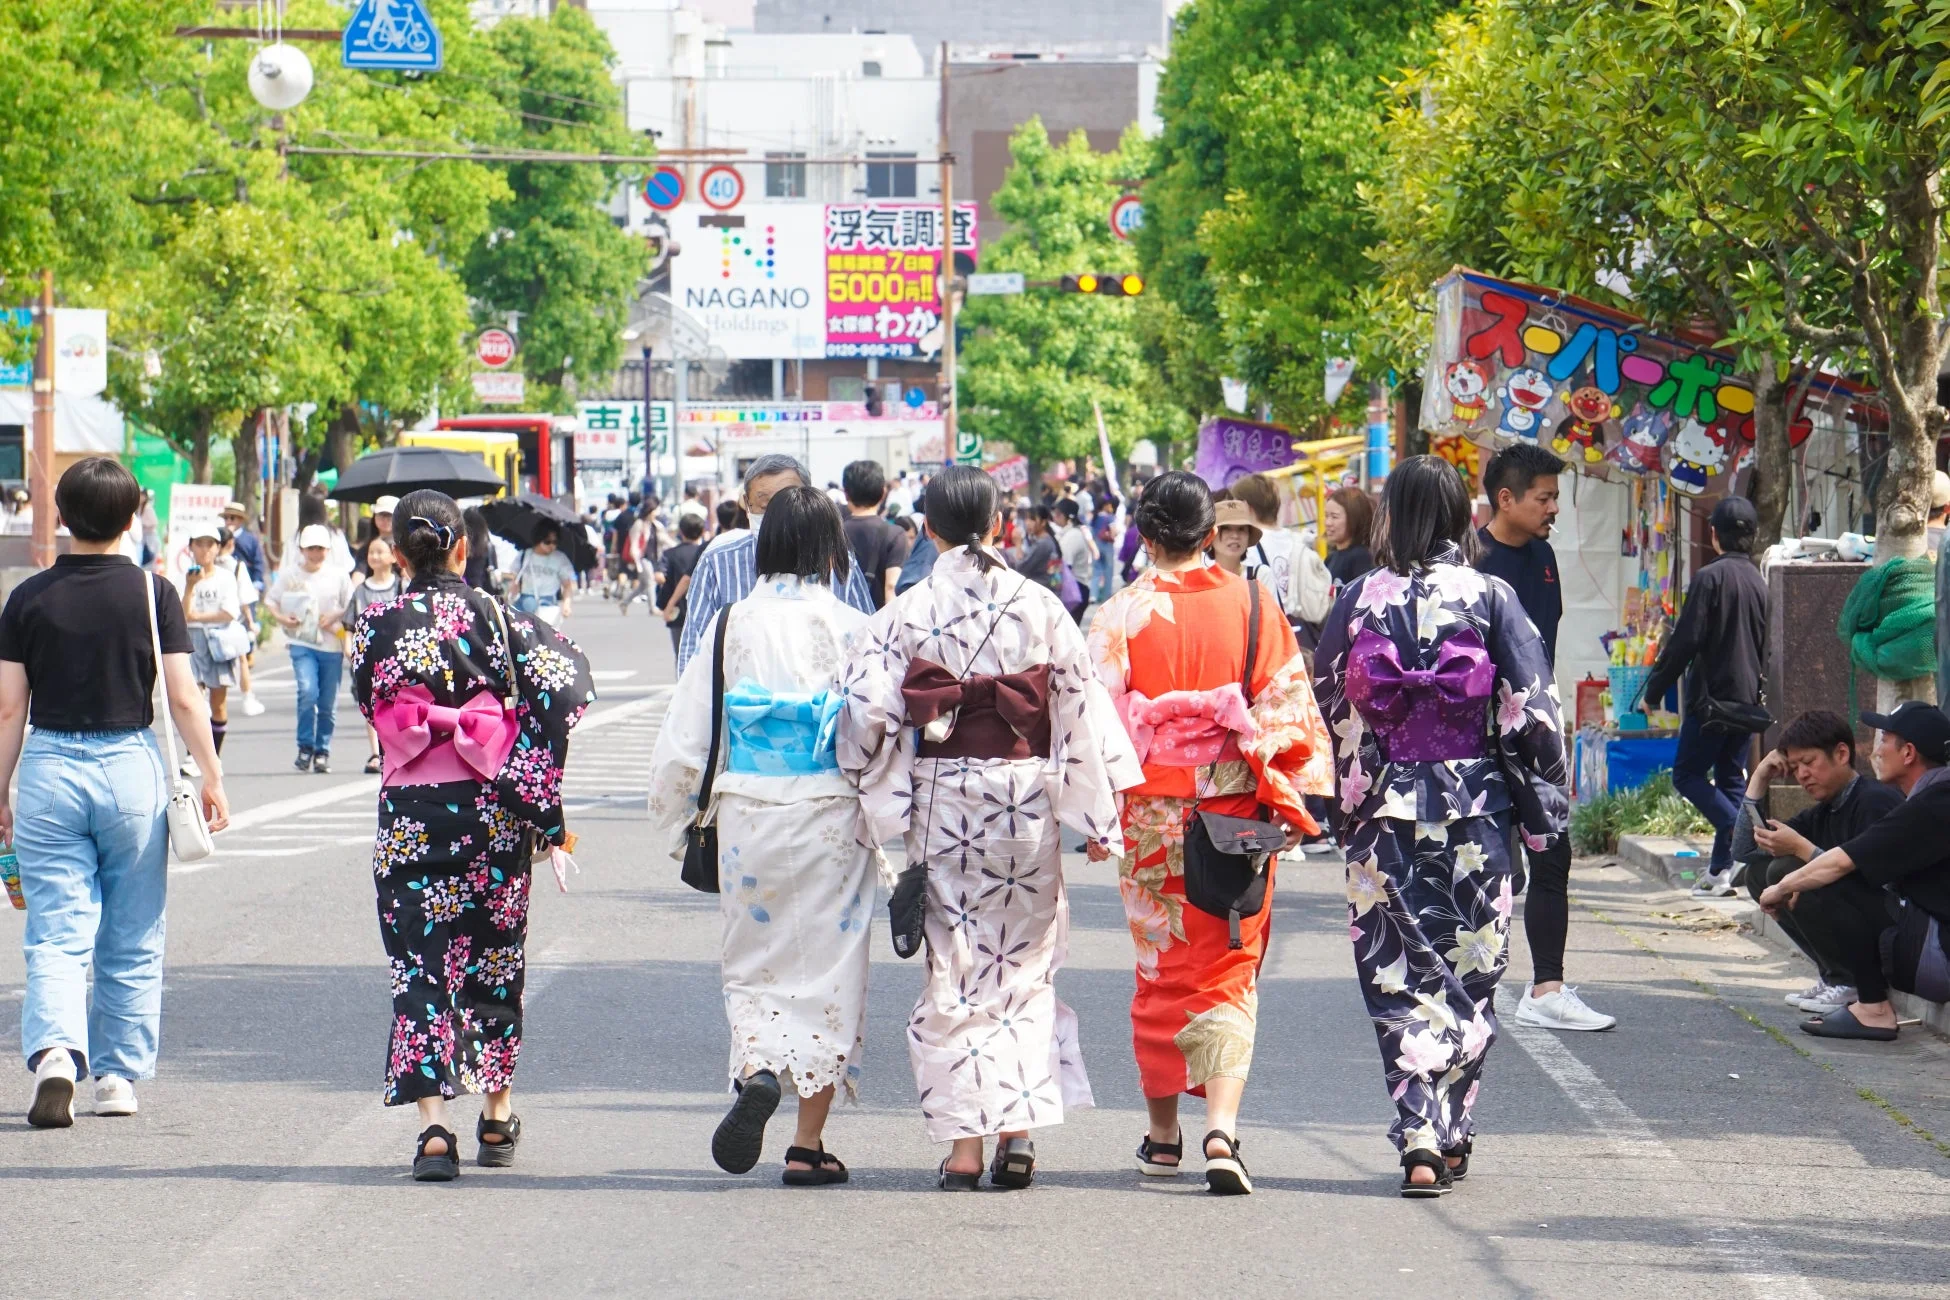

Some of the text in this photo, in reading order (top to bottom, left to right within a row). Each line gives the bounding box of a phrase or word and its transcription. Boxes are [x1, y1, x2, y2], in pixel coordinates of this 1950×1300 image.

[709, 178, 734, 198] 40
[830, 209, 971, 246] 浮気調査
[686, 288, 809, 308] NAGANO
[705, 313, 789, 334] Holdings
